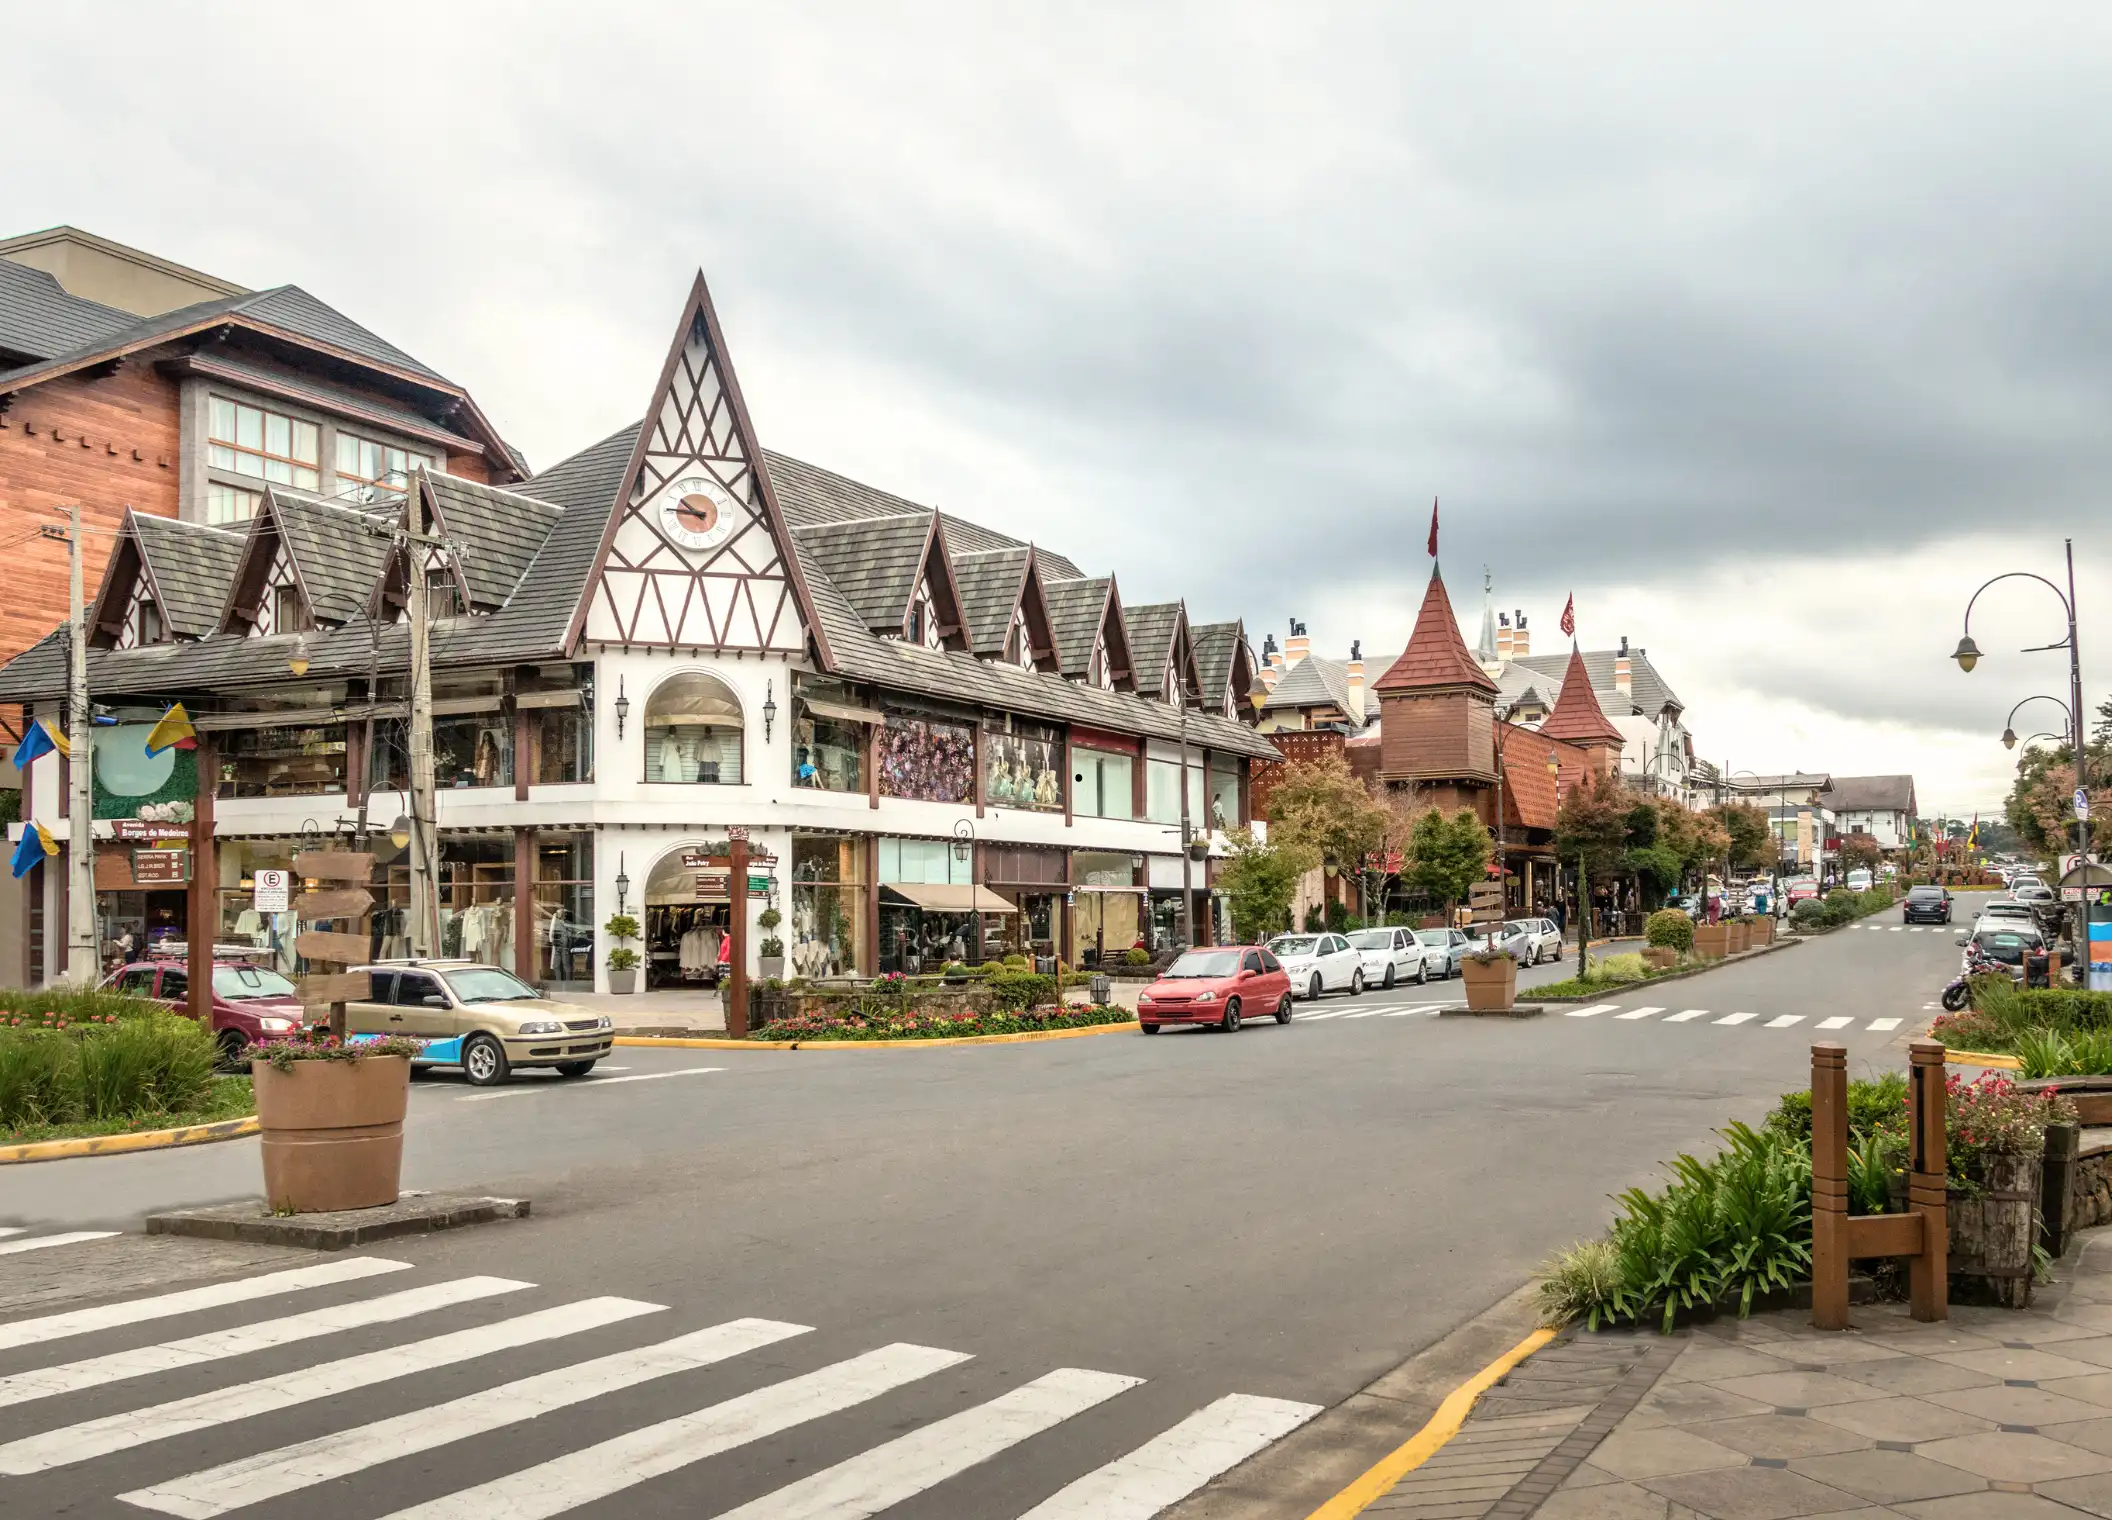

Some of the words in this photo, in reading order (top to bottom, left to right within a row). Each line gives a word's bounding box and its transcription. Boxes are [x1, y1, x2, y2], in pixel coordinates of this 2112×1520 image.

[122, 828, 147, 838] Borges
[148, 828, 158, 837] de
[159, 828, 189, 837] Medeiros
[268, 874, 277, 885] E
